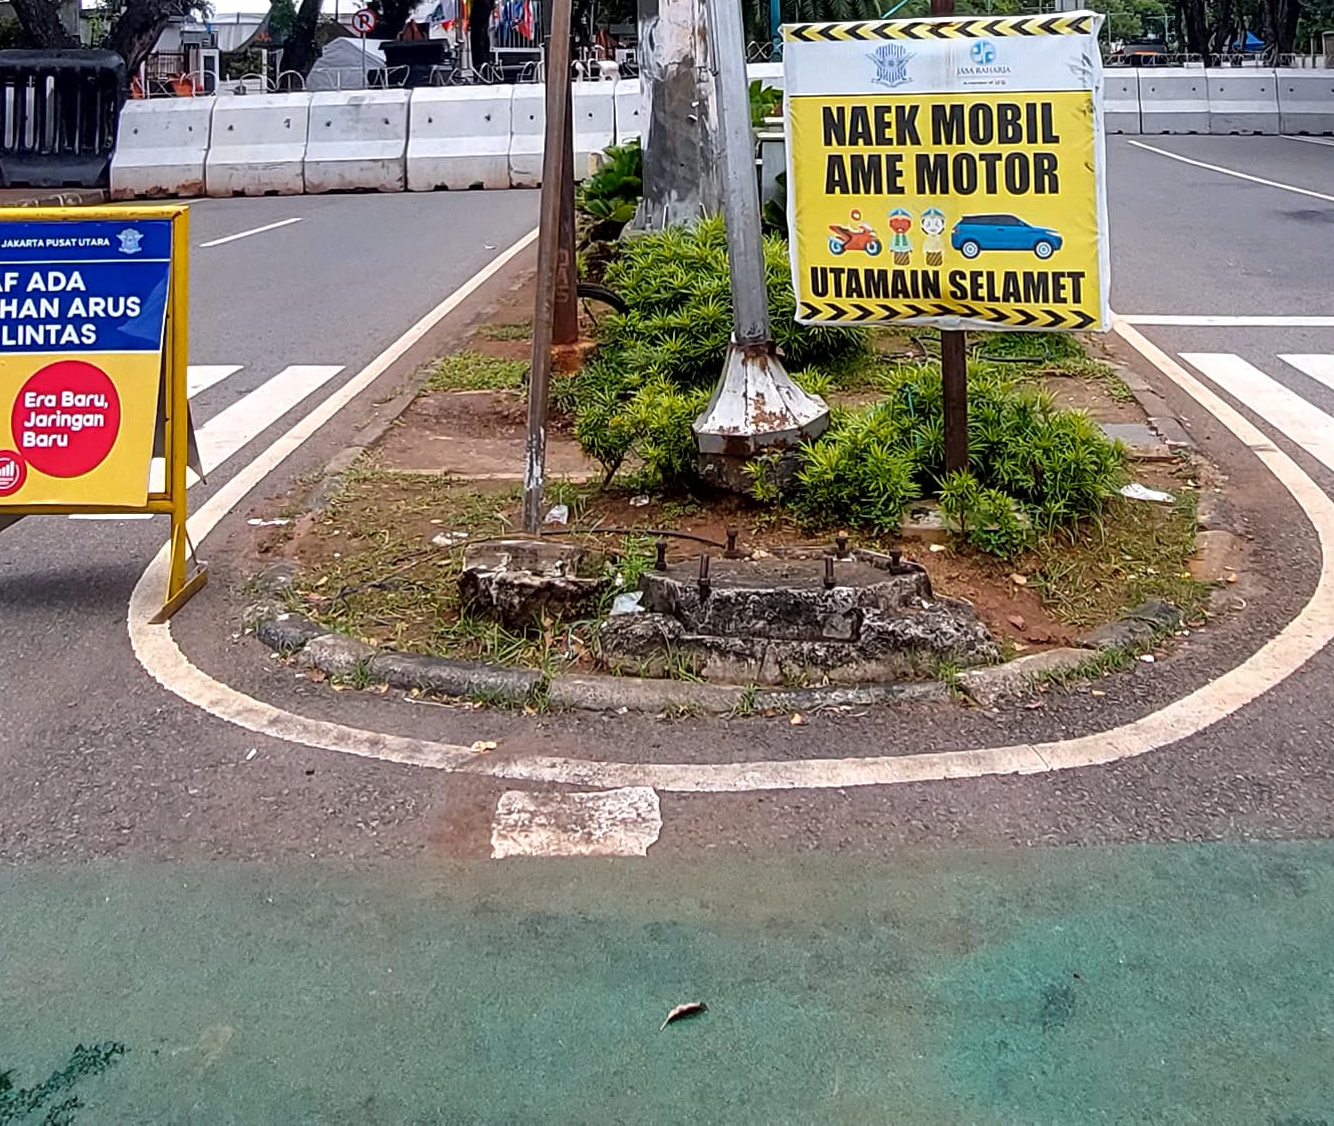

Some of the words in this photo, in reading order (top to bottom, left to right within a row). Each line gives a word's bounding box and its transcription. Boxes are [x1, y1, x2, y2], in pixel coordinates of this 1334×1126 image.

[822, 105, 922, 147] NAEK
[931, 102, 1060, 145] MOBIL
[825, 153, 905, 195] AME
[915, 152, 1060, 195] MOTOR
[1, 238, 44, 249] JAKARTA
[46, 238, 78, 248] PUSAT
[79, 237, 110, 247] UTARA
[26, 271, 86, 293] ADA
[810, 267, 942, 299] UTAMAIN
[949, 270, 1086, 304] SELAMET
[67, 296, 141, 319] ARUS
[1, 323, 97, 346] LINTAS
[24, 391, 57, 408] Era
[61, 390, 109, 410] Baru,
[23, 410, 105, 432] Jaringan
[23, 432, 69, 448] Baru
